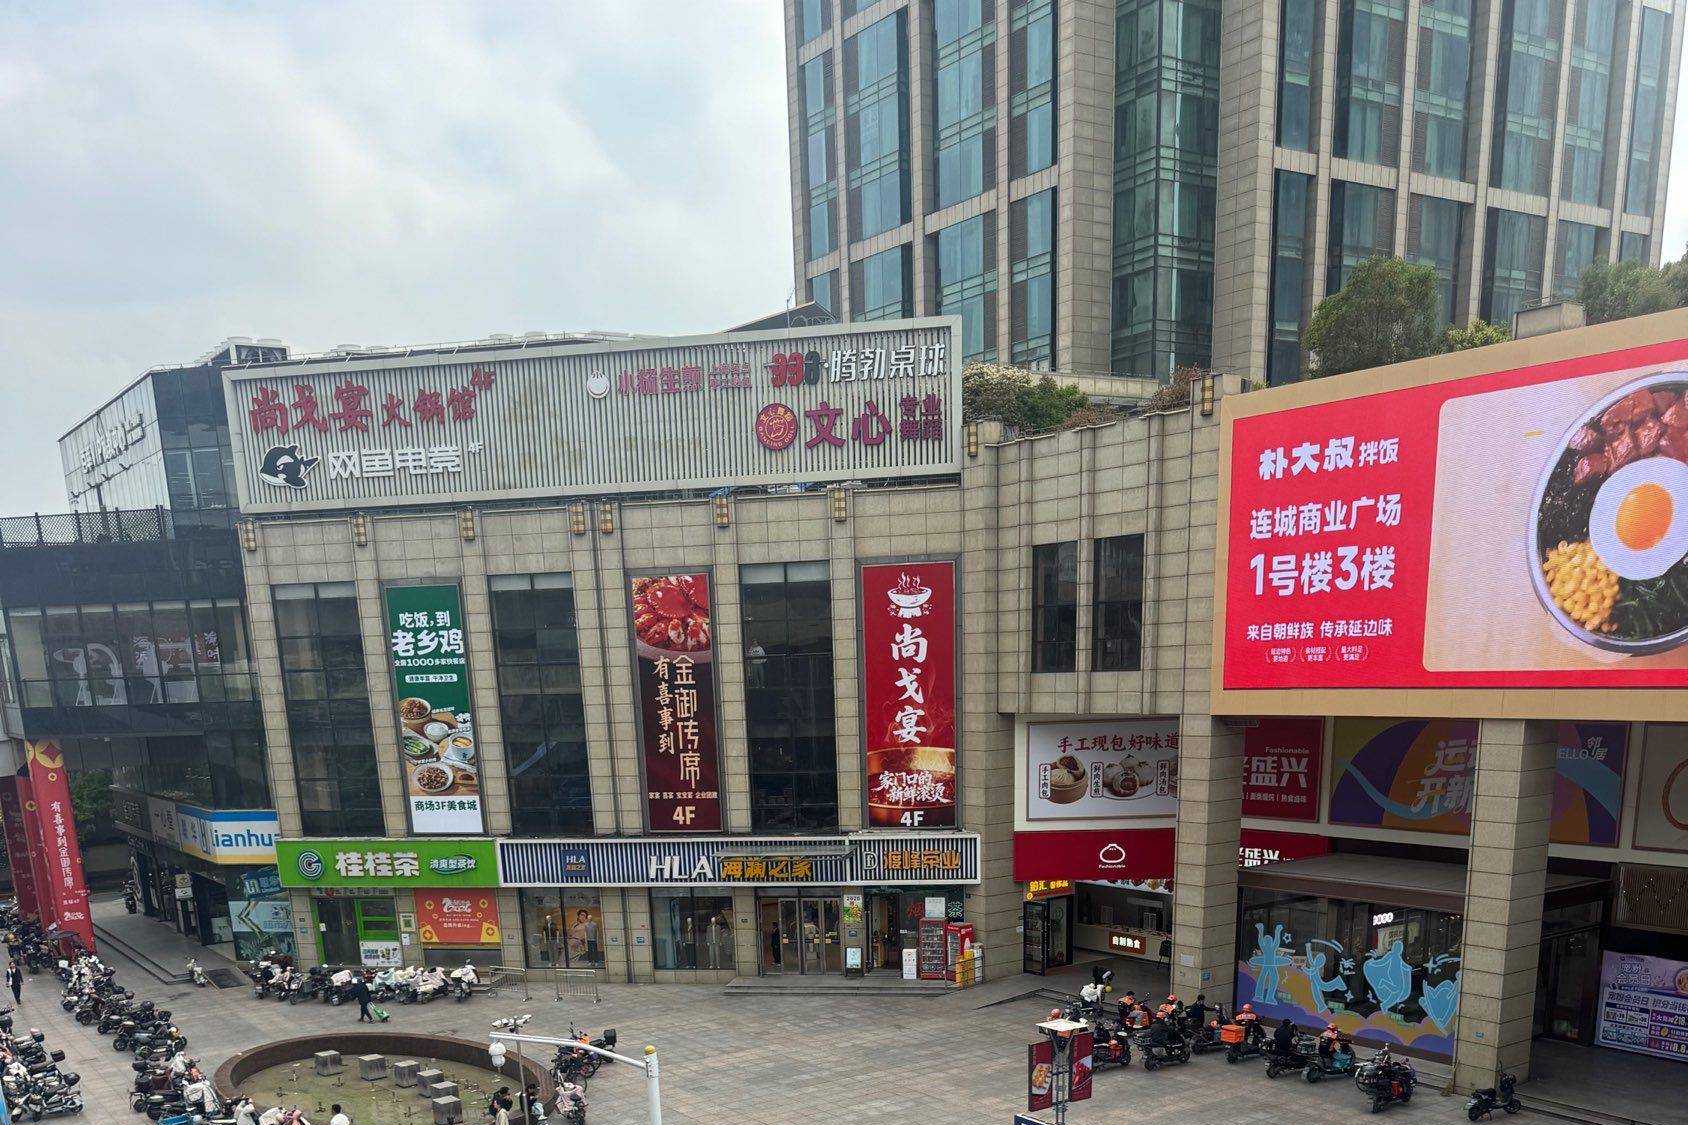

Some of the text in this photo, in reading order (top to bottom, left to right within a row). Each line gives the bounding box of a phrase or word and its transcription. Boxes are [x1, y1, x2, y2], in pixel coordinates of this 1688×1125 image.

[830, 342, 946, 384] 腾勃桌球
[470, 366, 497, 393] 4F
[804, 400, 893, 449] 文心
[327, 441, 485, 479] 网鱼电竞 4F
[1258, 436, 1400, 480] 朴大叔 拌饭
[1250, 493, 1402, 540] 连城商业广场
[1249, 545, 1396, 597] 1号楼3楼
[391, 628, 465, 657] 老乡鸡
[1247, 617, 1394, 641] 来自朝鲜族 传承延边味
[890, 623, 929, 744] 尚戈宴
[653, 654, 676, 755] 有喜事到
[672, 653, 701, 790] 金御传席
[1057, 732, 1179, 753] 手工现包好味道
[1265, 746, 1310, 755] Fashionable
[871, 770, 935, 791] 家门口的
[414, 798, 479, 813] 商场3F美食城
[672, 805, 696, 825] 4F
[900, 810, 925, 827] 4F
[335, 850, 421, 878] 桂桂茶
[565, 855, 586, 864] HLA
[650, 854, 814, 880] HLA 海澜之家
